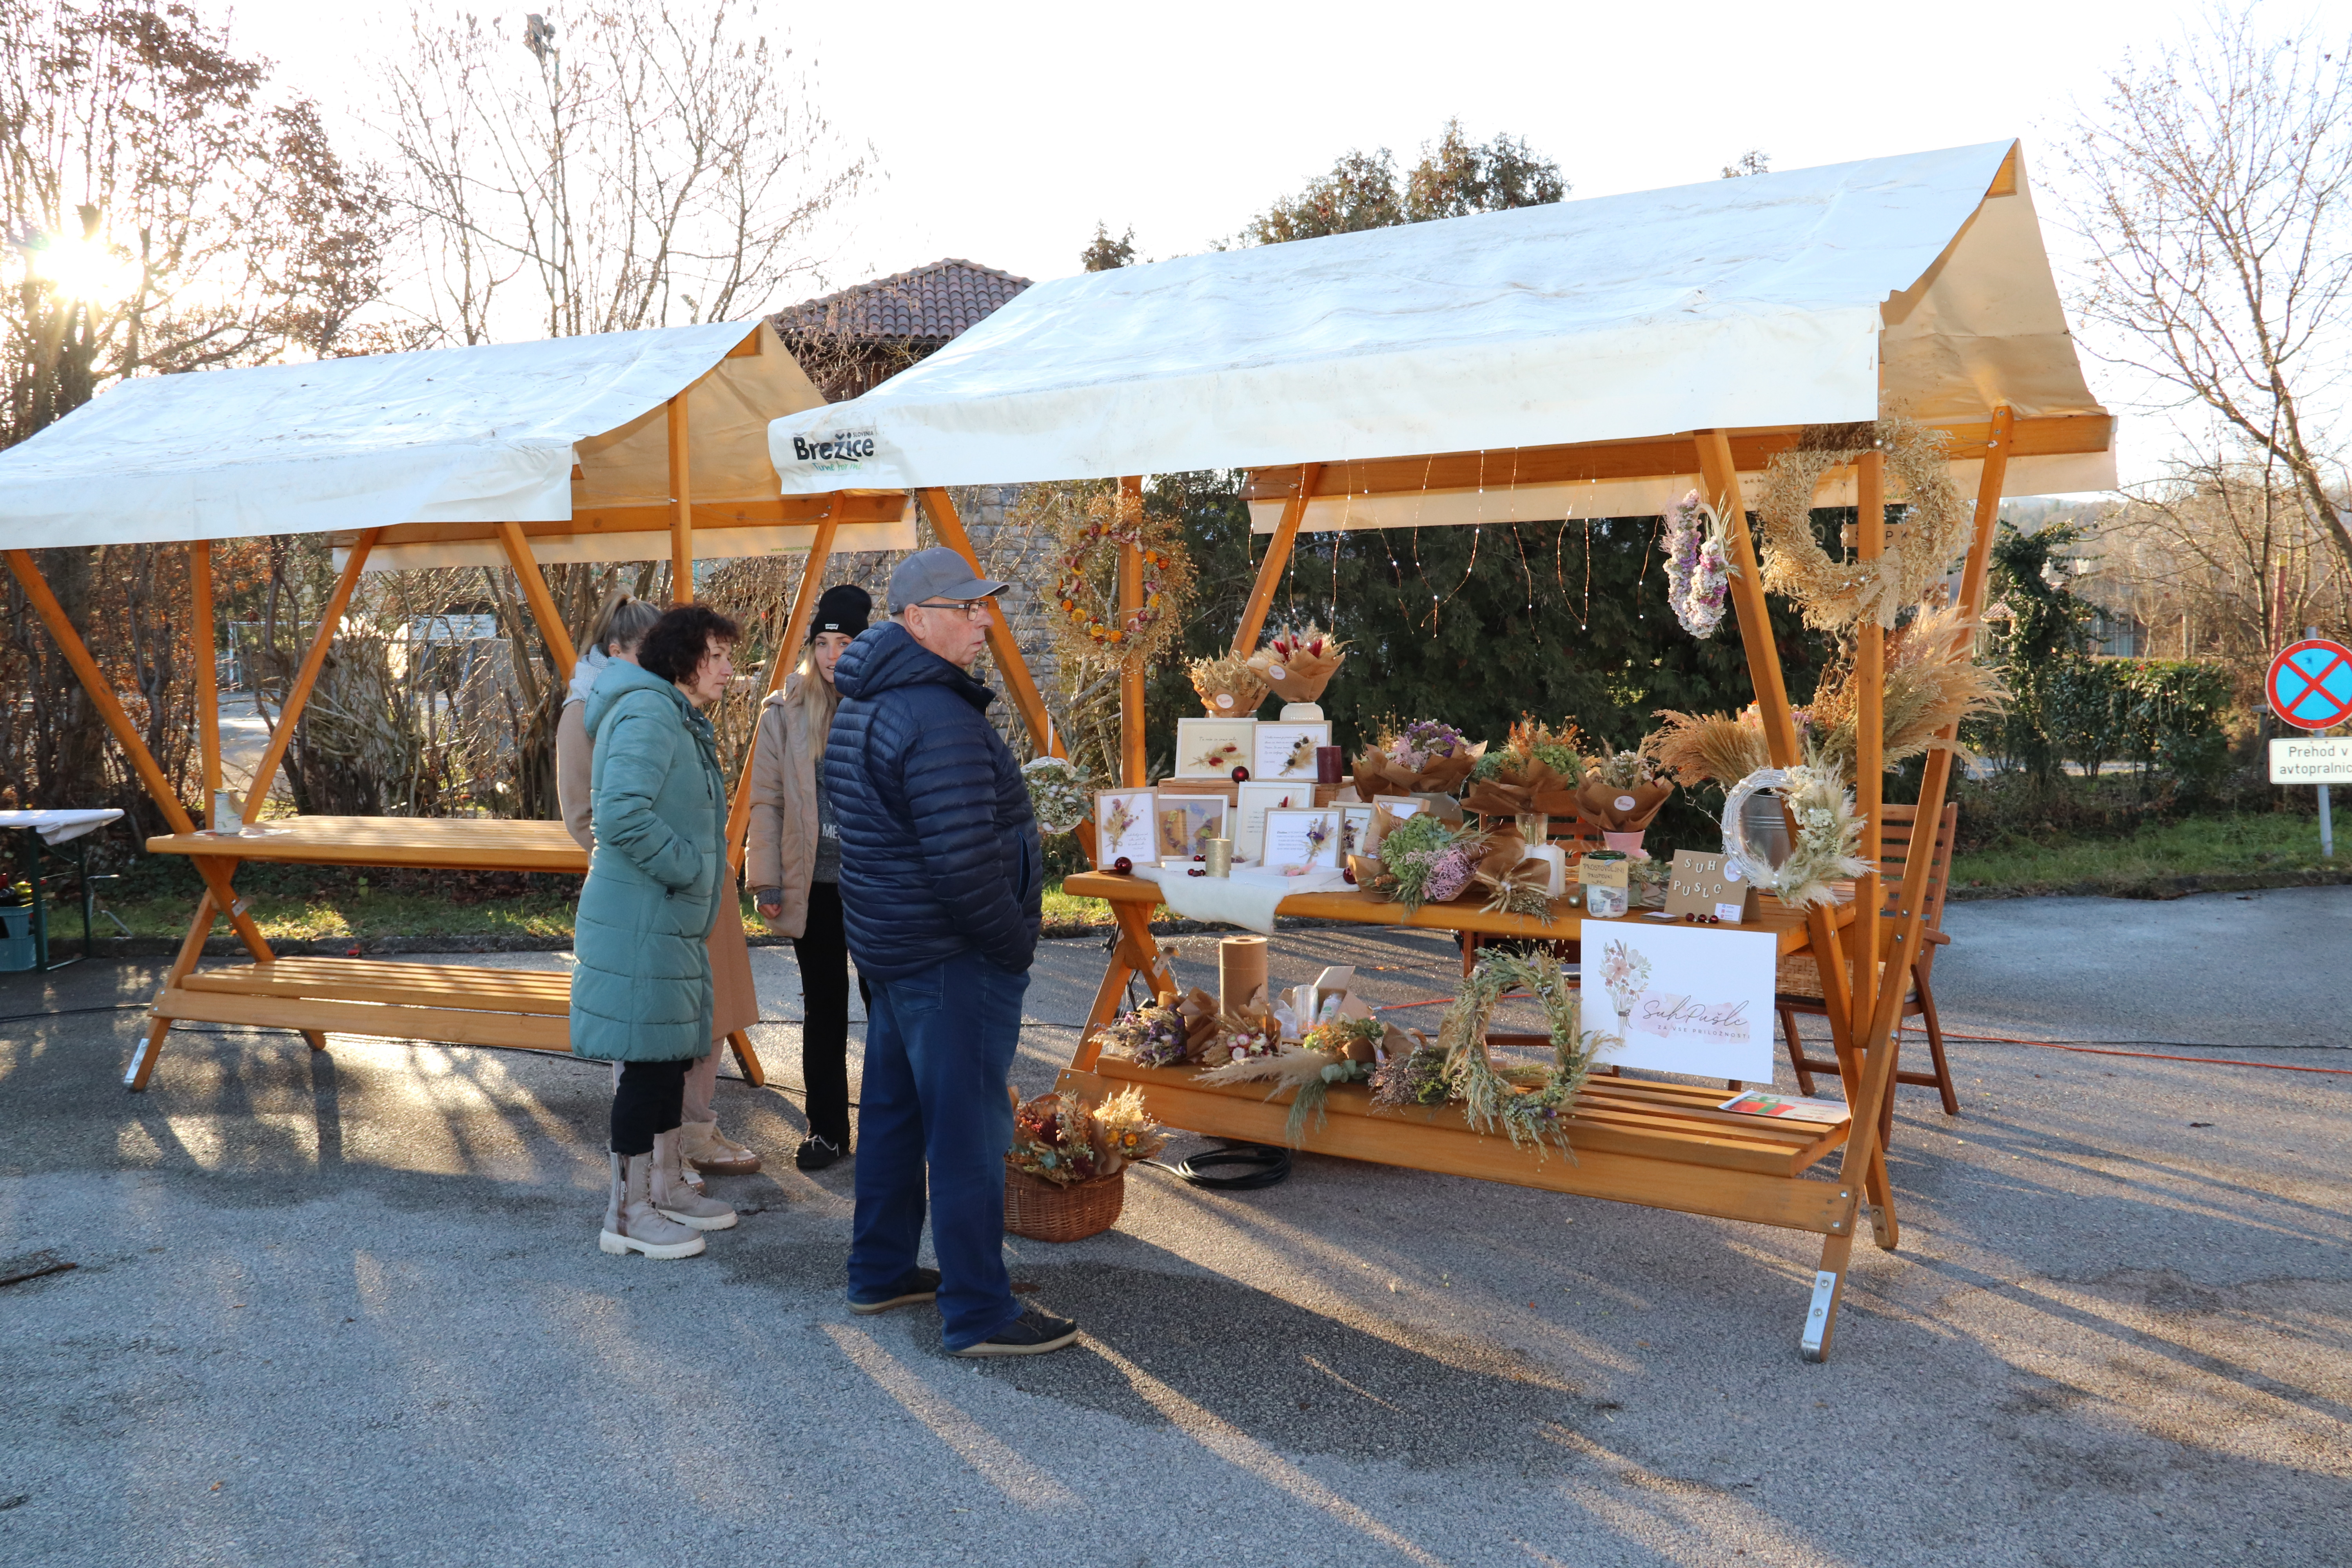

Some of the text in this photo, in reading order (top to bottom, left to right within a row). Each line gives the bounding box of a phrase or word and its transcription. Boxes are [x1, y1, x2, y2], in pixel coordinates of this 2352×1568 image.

[793, 432, 874, 461] Brežice
[812, 463, 835, 472] Time
[836, 461, 848, 472] for
[2288, 746, 2348, 757] Prehod v
[822, 824, 840, 839] ME
[1583, 863, 1624, 873] PROSTOVOLJNI
[1684, 858, 1717, 873] SUH
[1673, 880, 1722, 898] PUSLC
[1692, 1029, 1750, 1039] PRILOŽNOSTI
